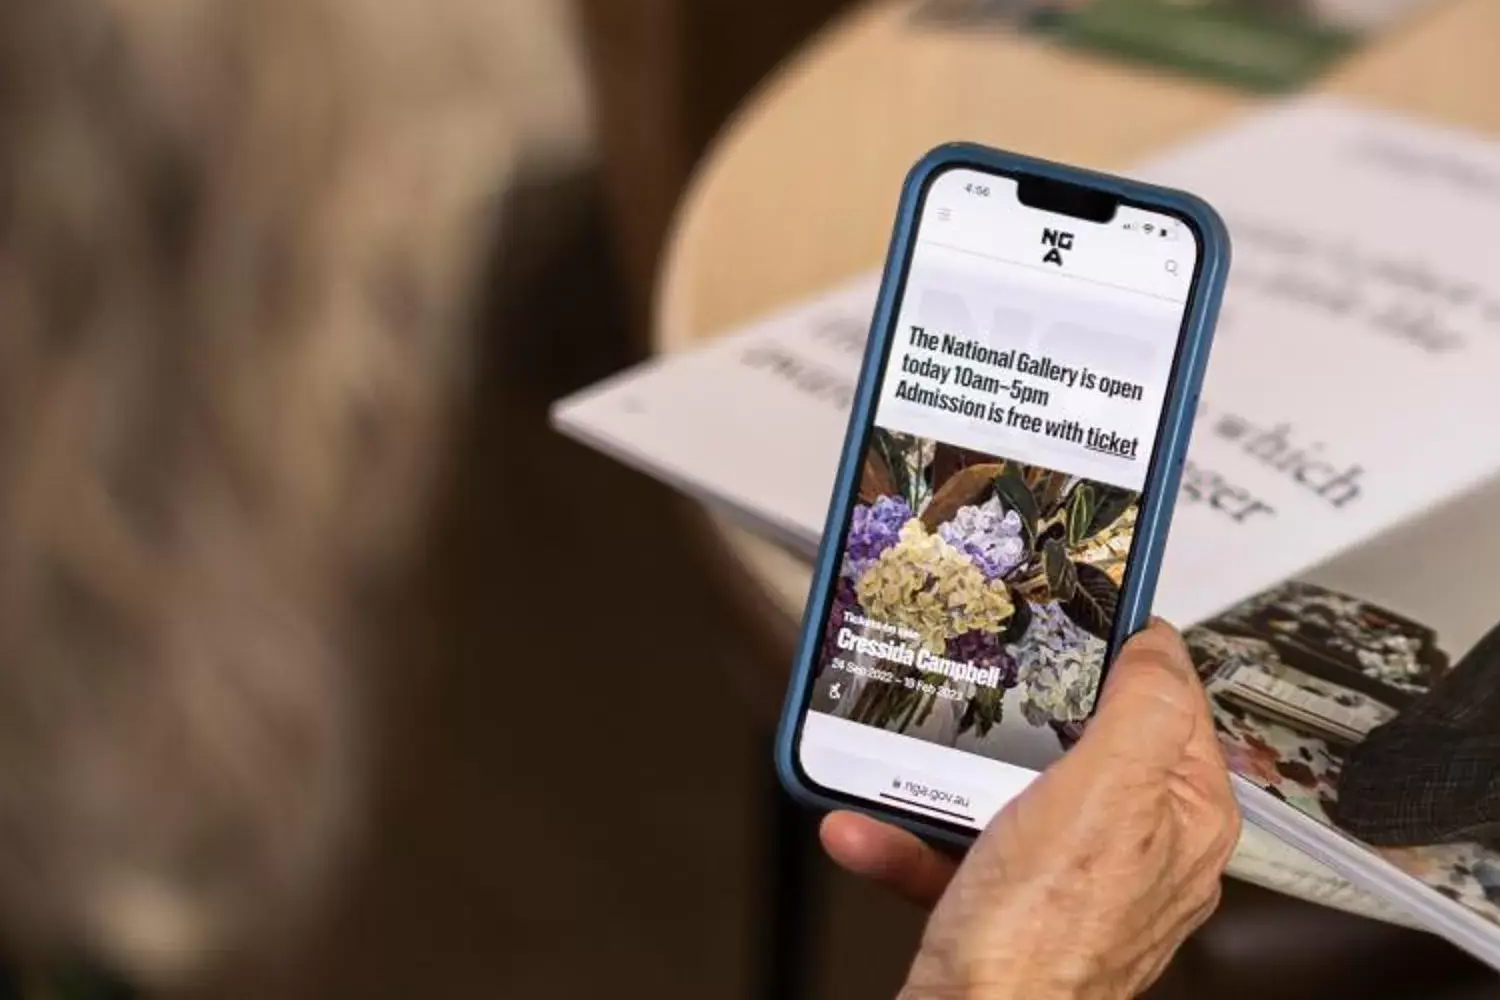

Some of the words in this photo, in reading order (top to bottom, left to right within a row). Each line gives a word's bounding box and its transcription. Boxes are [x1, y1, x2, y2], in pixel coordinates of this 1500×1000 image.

[965, 183, 991, 198] 4:56
[902, 353, 951, 384] today
[909, 325, 939, 351] The
[941, 333, 1016, 370] National
[1016, 352, 1079, 388] Gallery
[1080, 367, 1097, 390] is
[1099, 376, 1144, 401] open
[895, 380, 986, 419] Admission
[987, 401, 1005, 425] is
[1007, 406, 1043, 433] free
[1045, 419, 1085, 444] with
[1086, 426, 1139, 458] ticket
[837, 627, 915, 667] Cressida
[915, 648, 1001, 689] Campbell
[916, 681, 937, 696] Feb
[905, 781, 970, 807] nga.gov.au
